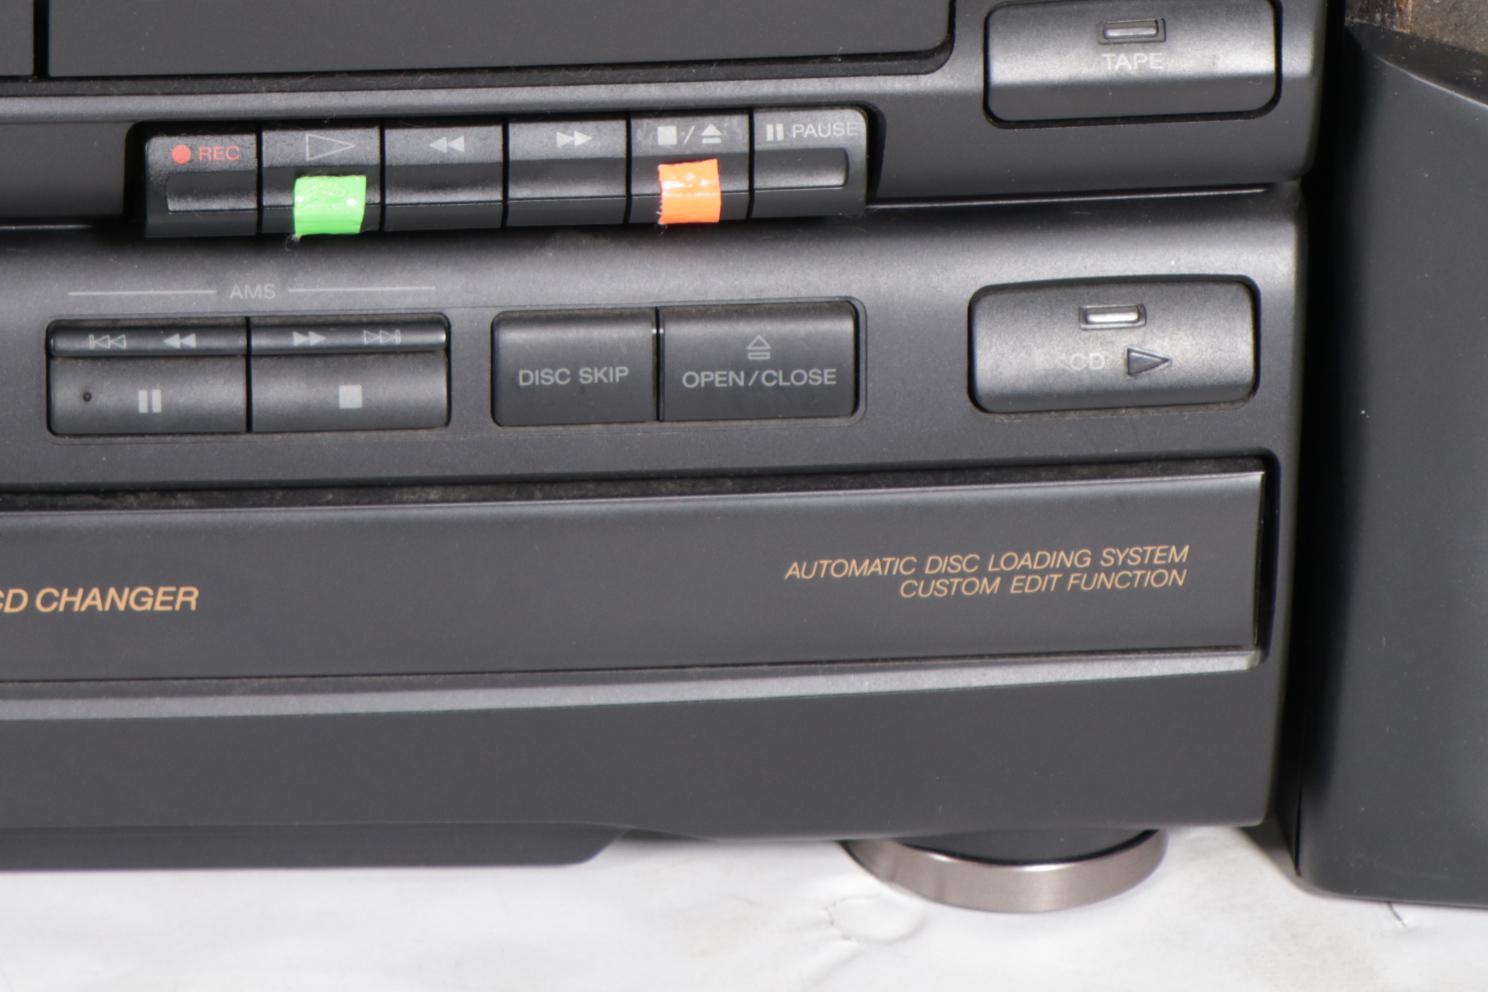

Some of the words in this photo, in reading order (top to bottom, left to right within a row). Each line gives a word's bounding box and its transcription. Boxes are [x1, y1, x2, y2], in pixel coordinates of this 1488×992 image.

[1101, 53, 1164, 70] TAPE
[791, 121, 858, 139] PAUSE
[197, 145, 241, 161] REC
[229, 283, 276, 300] AMS
[1070, 353, 1106, 371] CD
[519, 369, 570, 386] DISC
[578, 366, 629, 384] SKIP
[682, 369, 837, 388] OPEN/CLOSE
[784, 557, 917, 579] AUTOMATIC
[925, 554, 980, 575] DISC
[988, 549, 1092, 572] LOADING
[1100, 545, 1190, 567] SYSTEM
[900, 577, 1001, 598] CUSTOM
[1011, 574, 1060, 594] EDIT
[1068, 569, 1187, 591] FUNCTION
[35, 586, 199, 613] CHANGER
